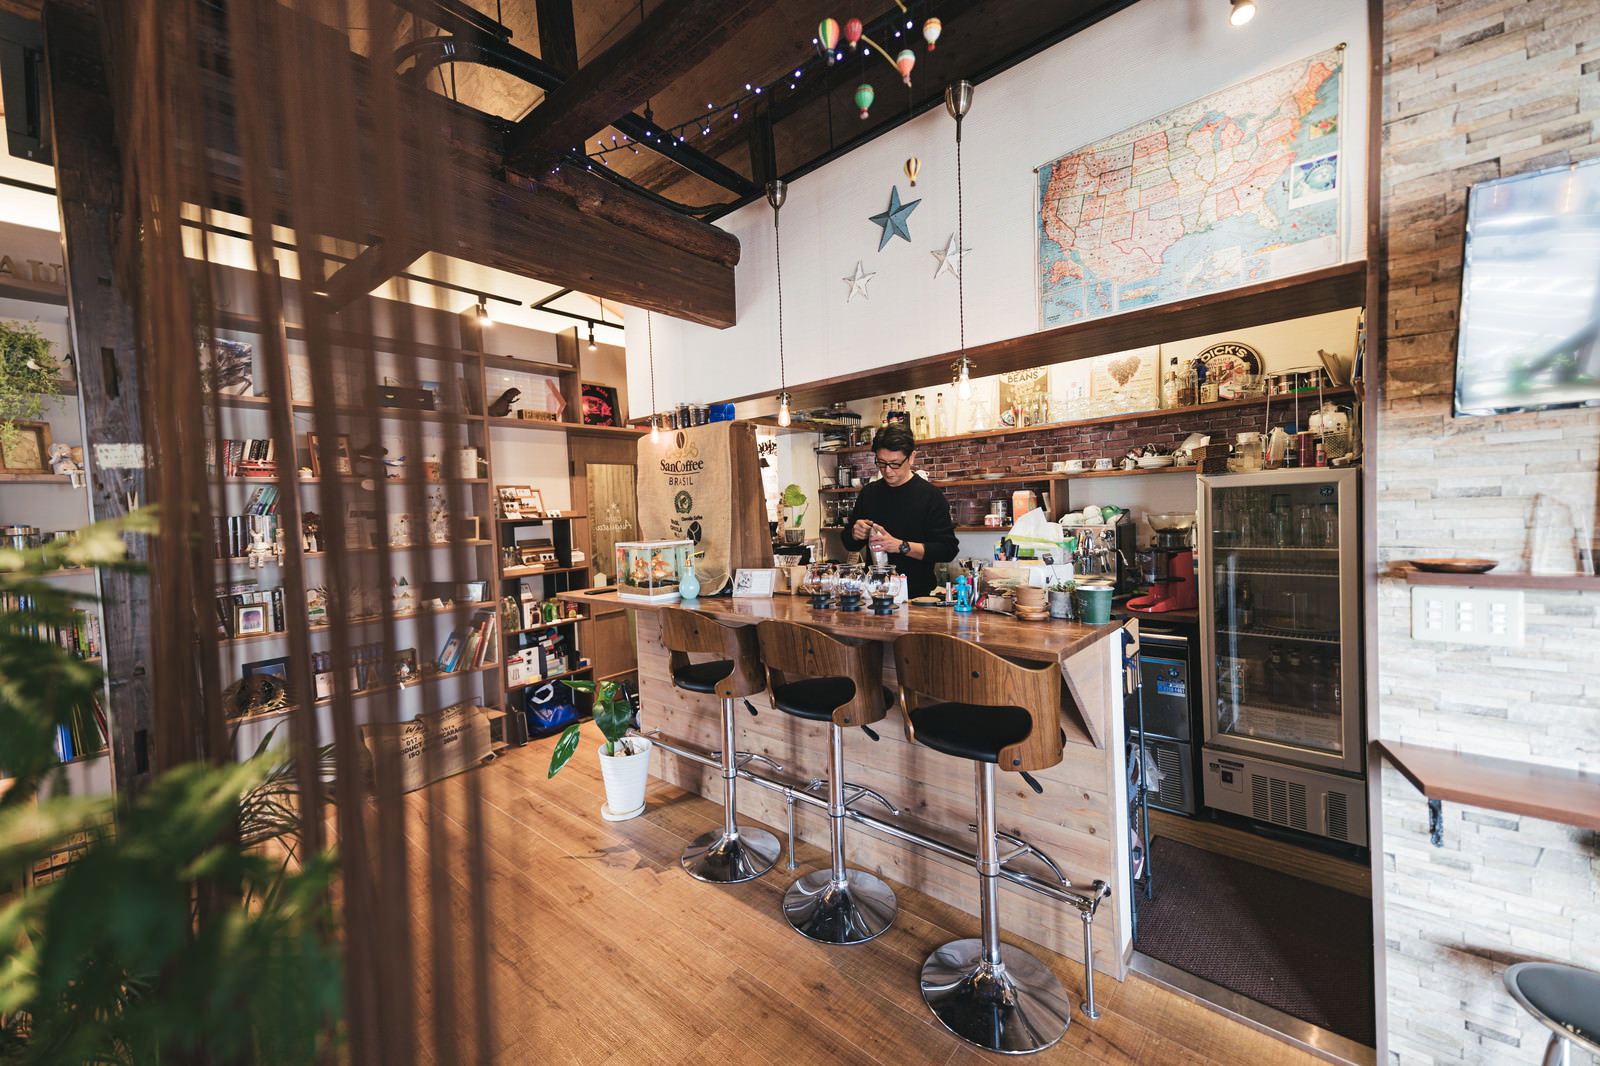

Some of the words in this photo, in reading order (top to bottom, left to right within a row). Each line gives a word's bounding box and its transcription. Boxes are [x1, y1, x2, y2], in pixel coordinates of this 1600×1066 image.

[1200, 345, 1248, 363] DICK'S
[1007, 371, 1039, 383] BEANS
[660, 459, 704, 472] SanCoffee
[668, 476, 694, 486] BRASIL
